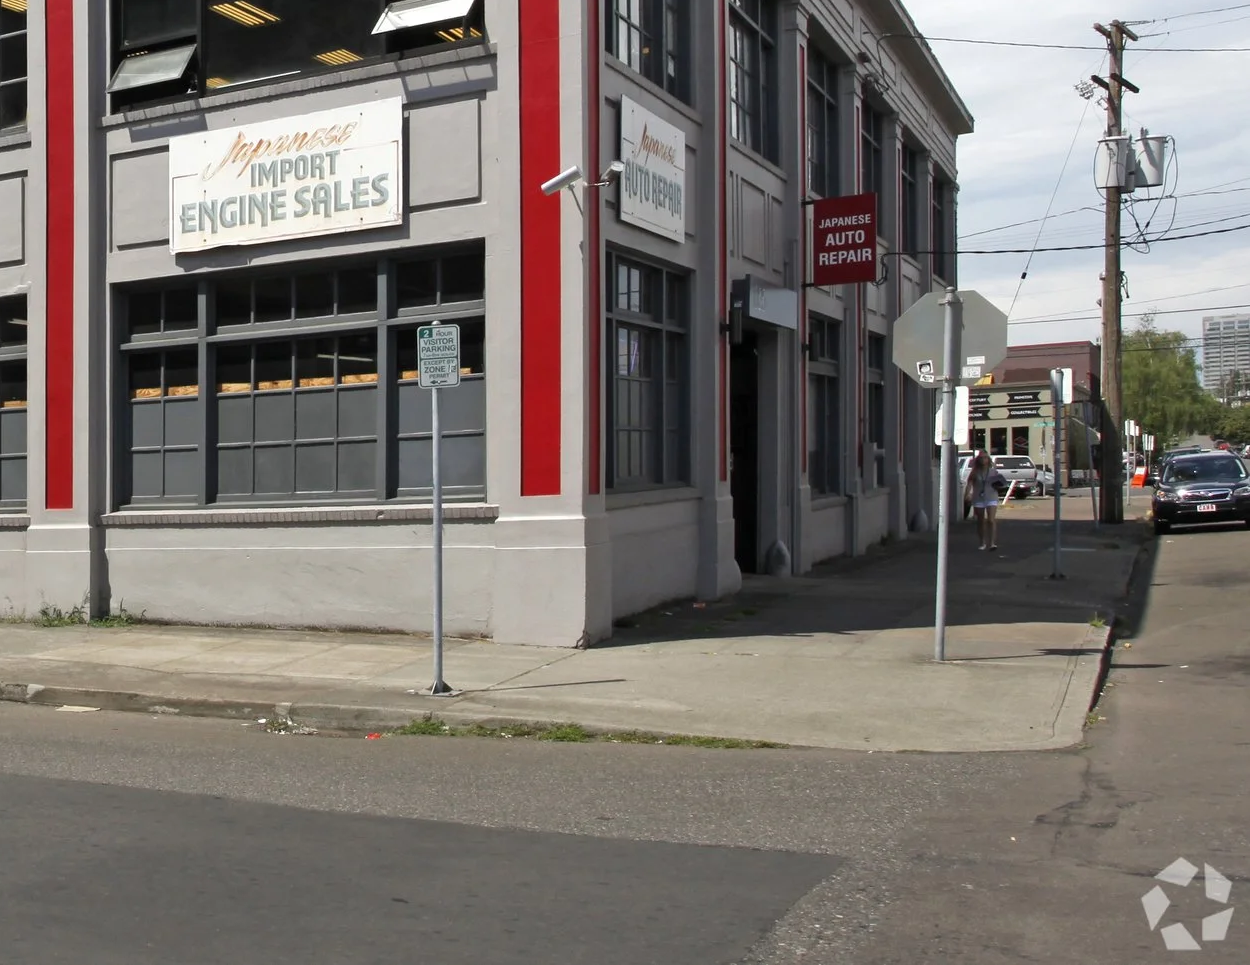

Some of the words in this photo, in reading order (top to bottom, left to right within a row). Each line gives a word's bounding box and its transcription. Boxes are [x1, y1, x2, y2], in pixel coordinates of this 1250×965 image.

[202, 121, 358, 181] Japanese
[250, 150, 340, 188] IMPORT
[624, 158, 650, 204] AUTO
[652, 173, 682, 220] REPAIR
[179, 189, 288, 234] ENGINE
[293, 173, 389, 218] SALES
[819, 214, 871, 228] JAPANESE
[825, 229, 865, 246] AUTO
[819, 248, 872, 266] REPAIR
[421, 345, 456, 353] PARKING
